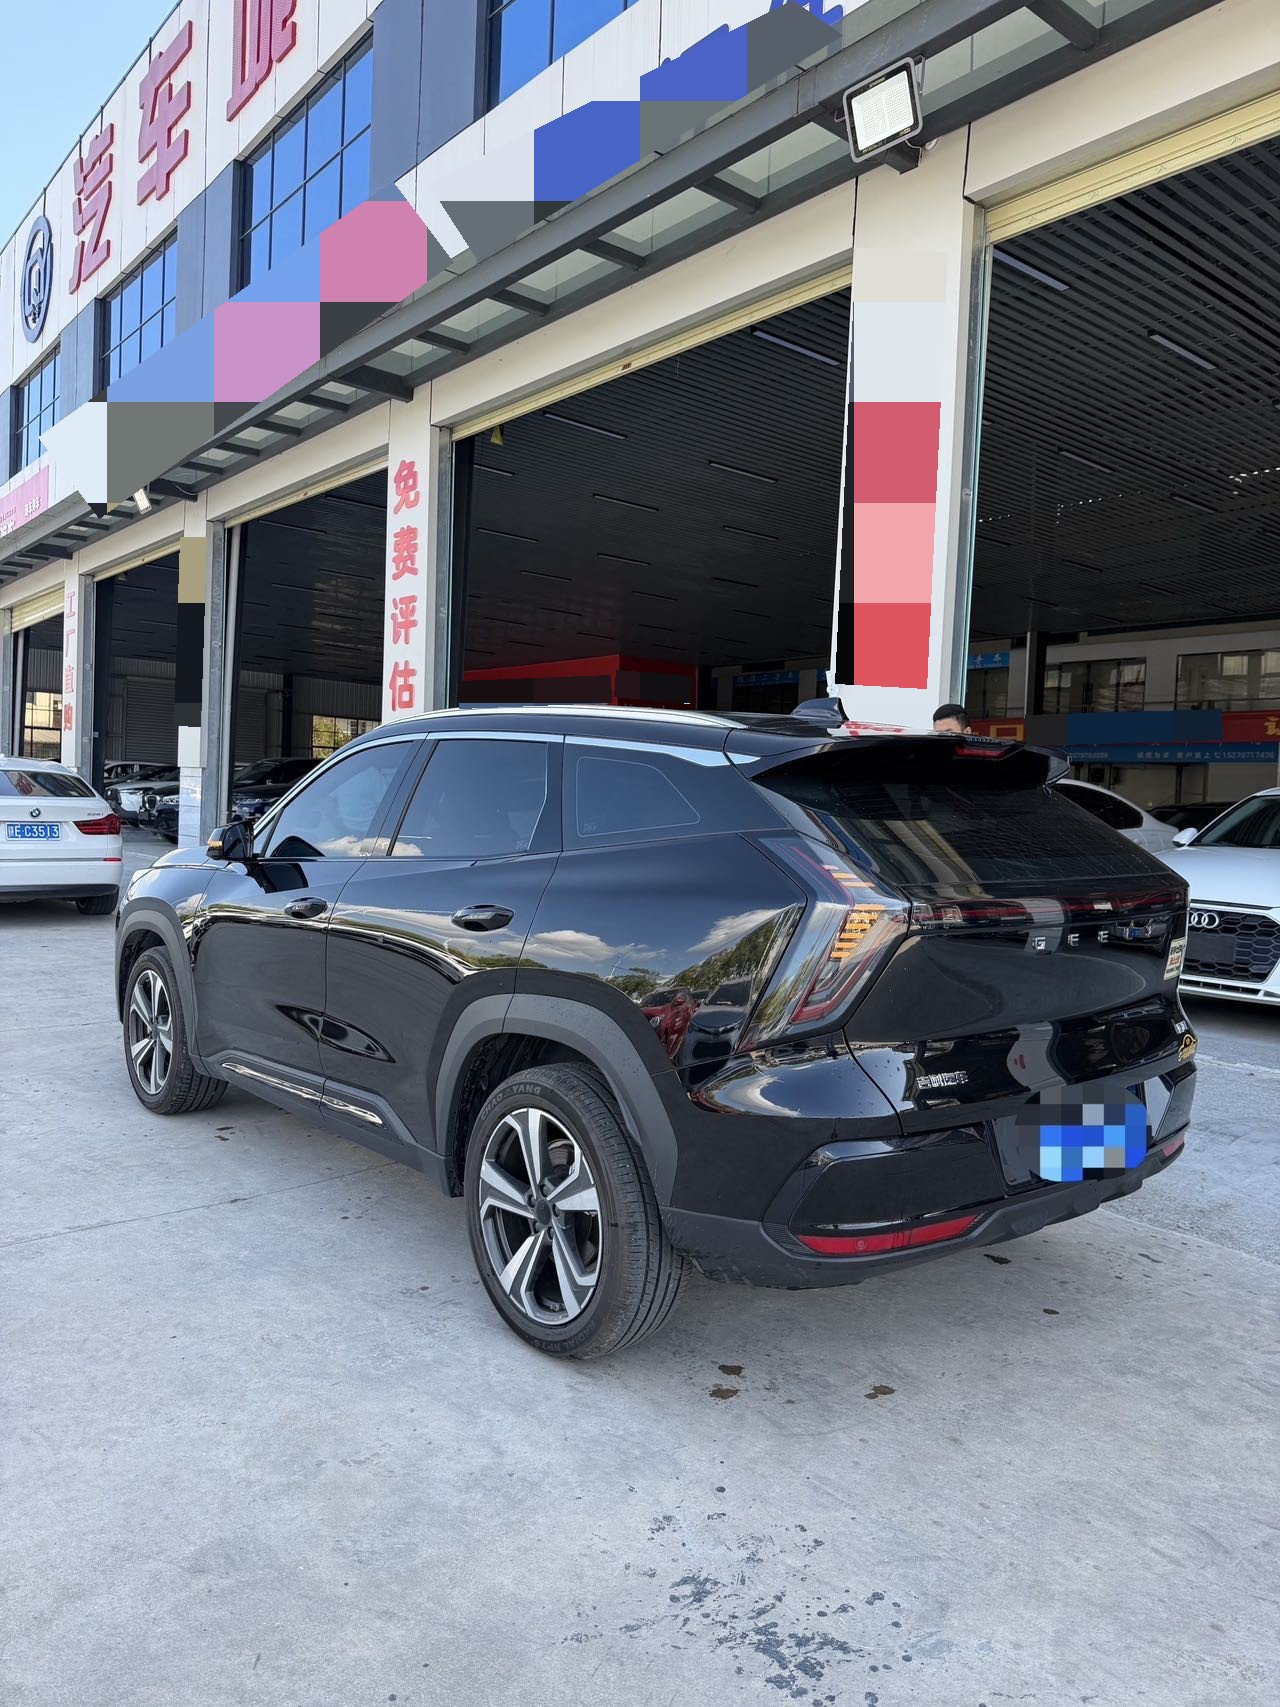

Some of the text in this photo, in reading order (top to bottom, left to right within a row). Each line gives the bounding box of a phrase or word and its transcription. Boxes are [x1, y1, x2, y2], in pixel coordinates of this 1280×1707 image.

[389, 459, 420, 711] 免费评估
[63, 591, 76, 731] 工厂直购
[512, 1084, 542, 1095] YANG
